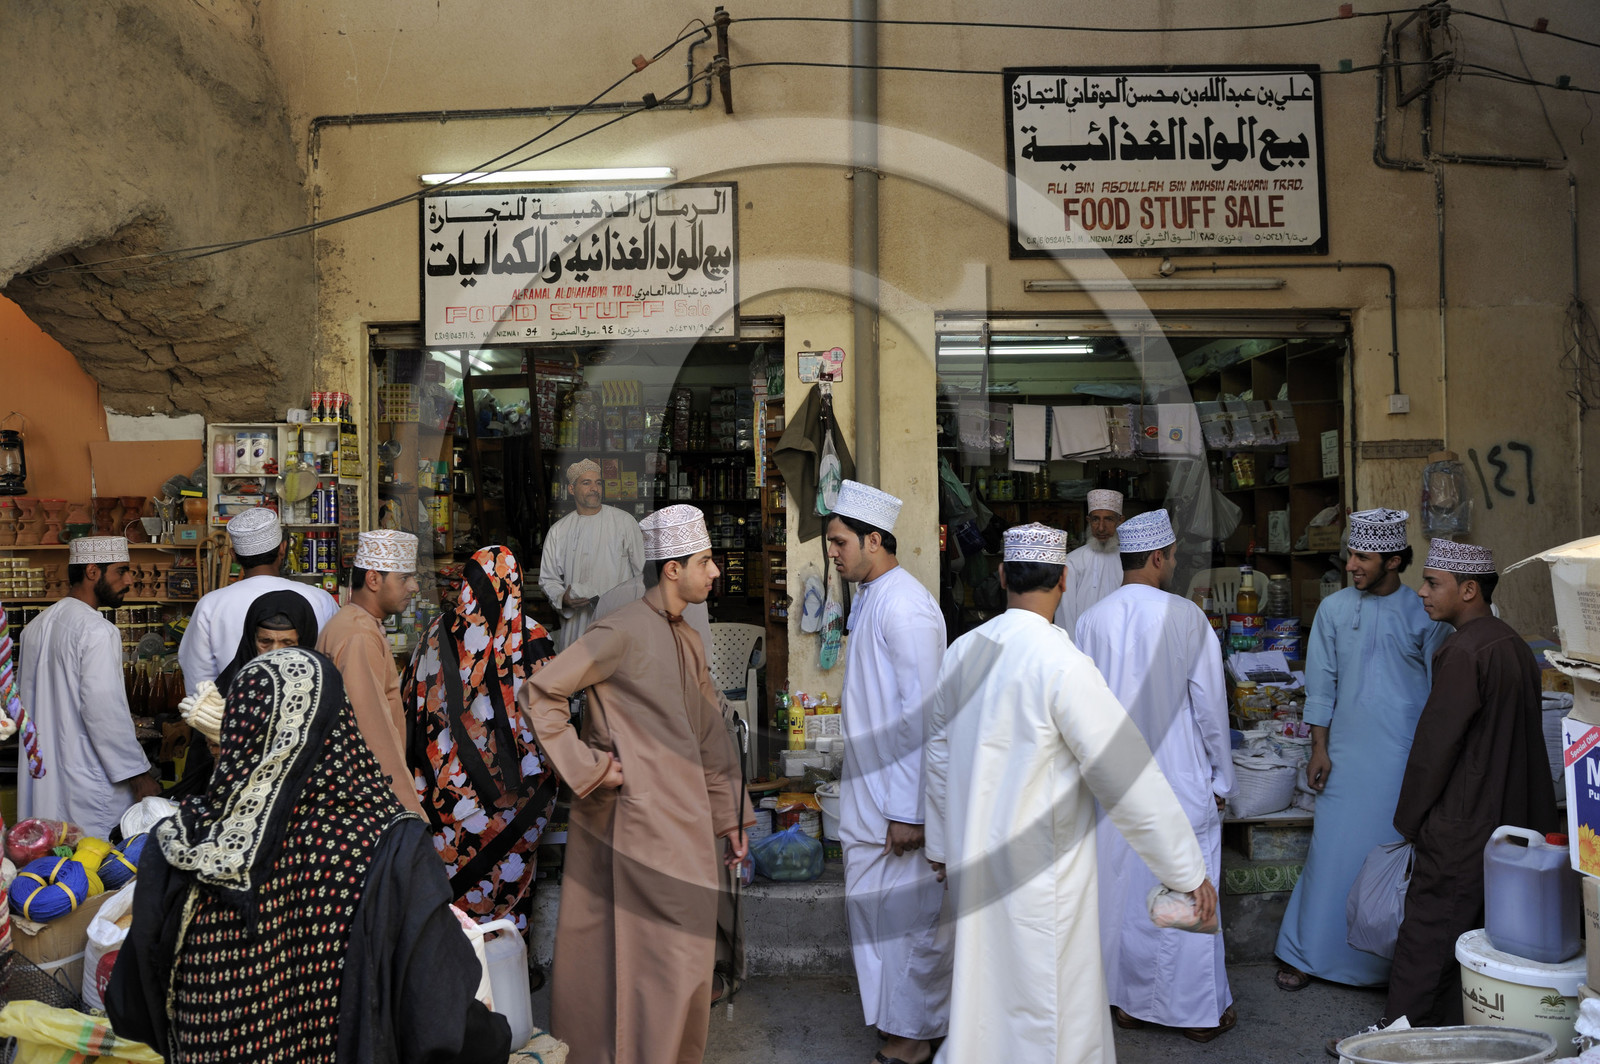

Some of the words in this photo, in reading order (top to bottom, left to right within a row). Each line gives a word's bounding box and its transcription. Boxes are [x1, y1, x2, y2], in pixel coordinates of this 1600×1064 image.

[1013, 78, 1067, 110] للتجارة
[1126, 87, 1180, 108] محسن
[1181, 87, 1199, 108] بن
[1257, 86, 1274, 107] بن
[1274, 77, 1313, 111] علي
[1021, 115, 1187, 172] الغذائية
[1188, 115, 1258, 171] المواد
[1257, 129, 1310, 171] بيع
[1047, 182, 1067, 194] ALI
[1075, 182, 1095, 194] BIN
[1101, 181, 1164, 193] ABDULLAH
[1169, 180, 1187, 192] BIN
[1190, 180, 1225, 192] MOHSIN
[428, 195, 527, 233] للتجارة
[531, 191, 636, 226] الذهبية
[639, 188, 726, 224] الرمال
[1063, 197, 1130, 231] FOOD
[1140, 195, 1217, 230] STUFF
[1224, 195, 1285, 229] SALE
[427, 225, 562, 288] والكماليات
[563, 221, 655, 283] الغذائية
[656, 219, 703, 281] المواد
[1116, 235, 1133, 244] 285
[702, 245, 731, 281] بيع
[445, 303, 537, 324] FOOD
[550, 299, 665, 321] STUFF
[674, 300, 712, 317] Sale
[525, 327, 538, 336] 94
[1570, 740, 1587, 758] Special
[1586, 732, 1599, 744] Offer
